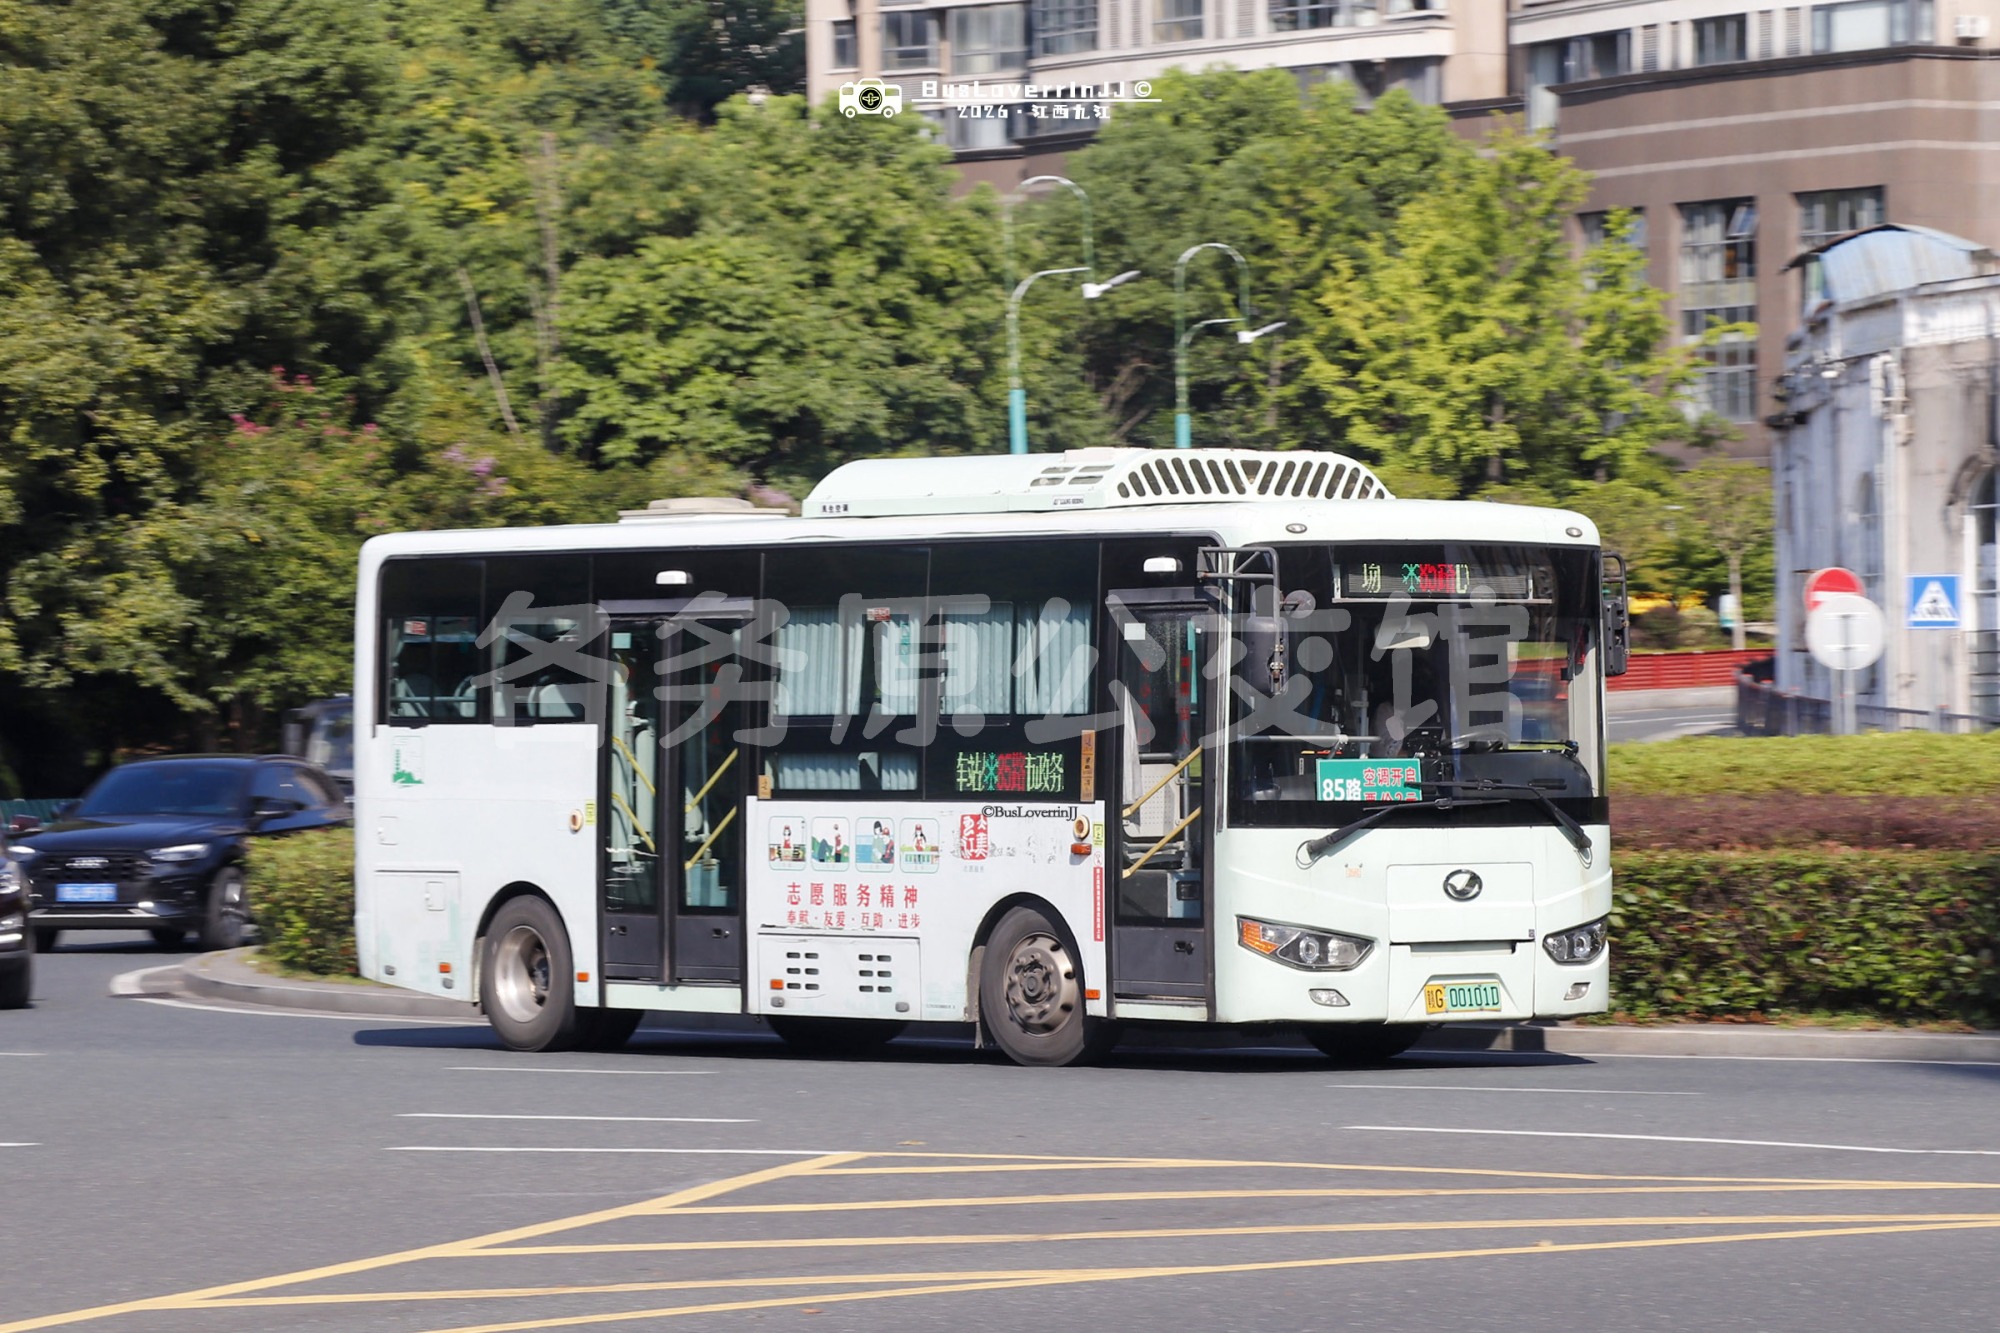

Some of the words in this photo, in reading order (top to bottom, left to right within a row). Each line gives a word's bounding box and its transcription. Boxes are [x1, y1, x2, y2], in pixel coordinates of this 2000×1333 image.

[1363, 767, 1416, 787] 空调开启
[1322, 779, 1361, 800] 85路
[787, 882, 918, 909] 志愿服务精神
